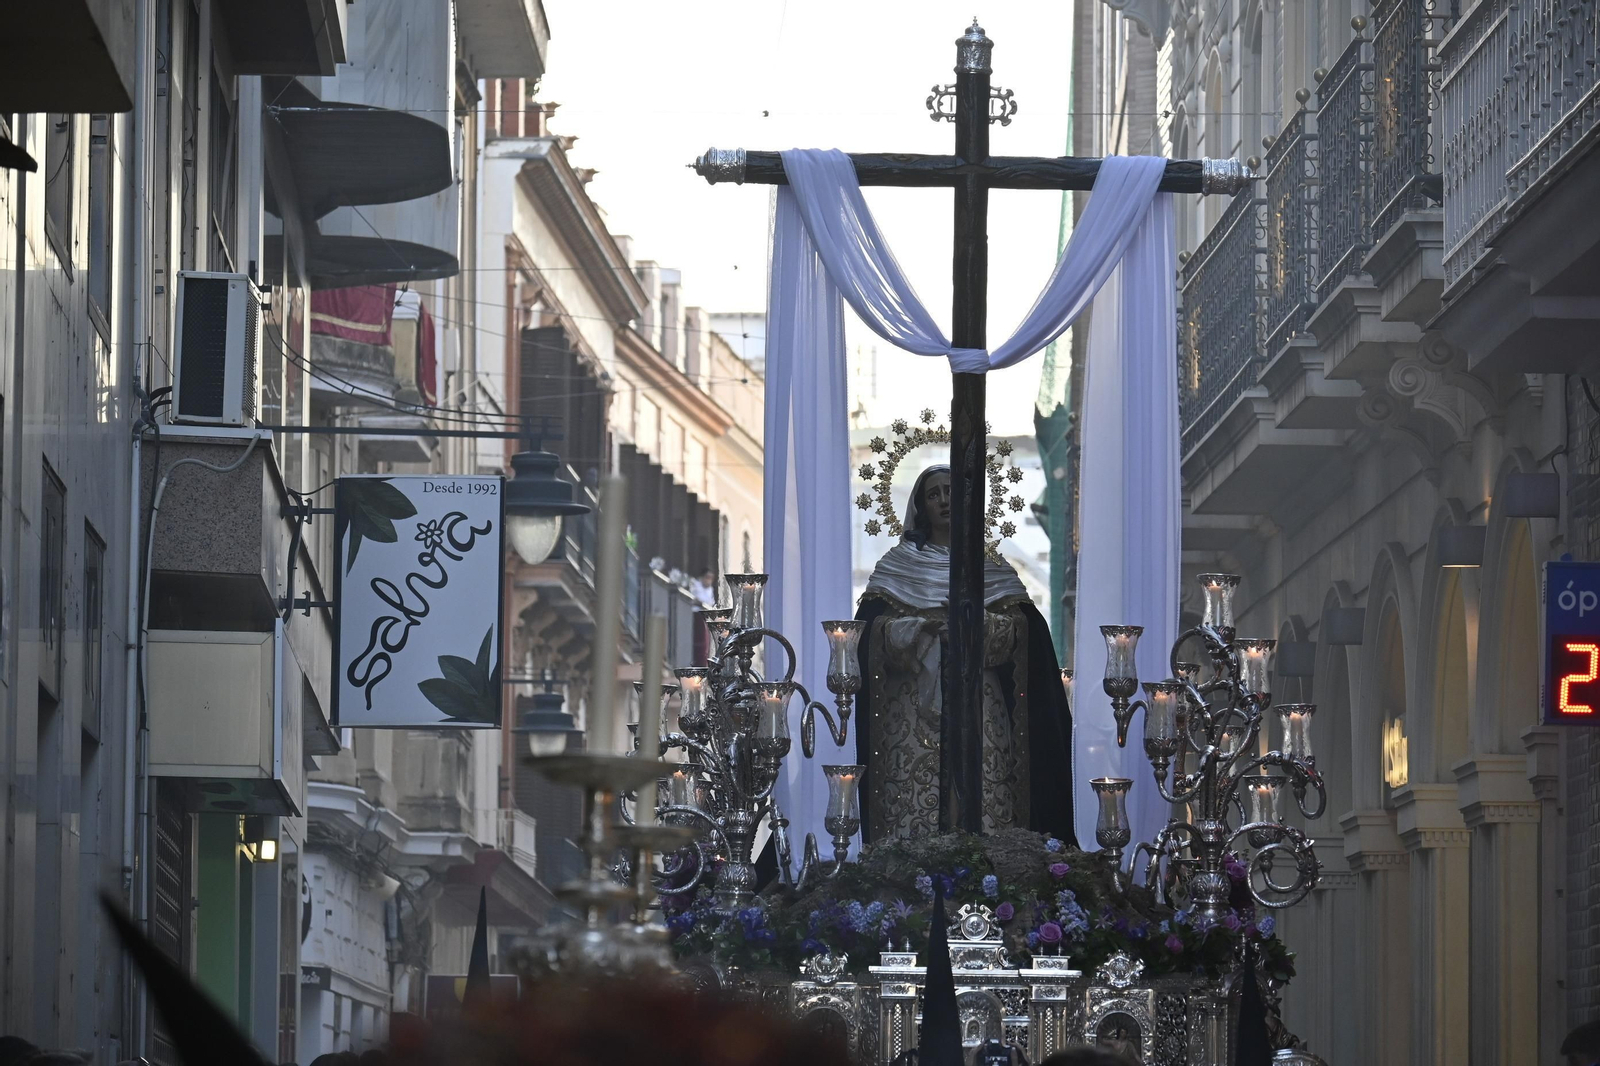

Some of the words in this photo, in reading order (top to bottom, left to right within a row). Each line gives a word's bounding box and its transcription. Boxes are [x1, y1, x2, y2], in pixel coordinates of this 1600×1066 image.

[422, 481, 463, 494] Desde
[467, 483, 498, 496] 1992
[1559, 643, 1599, 713] 2
